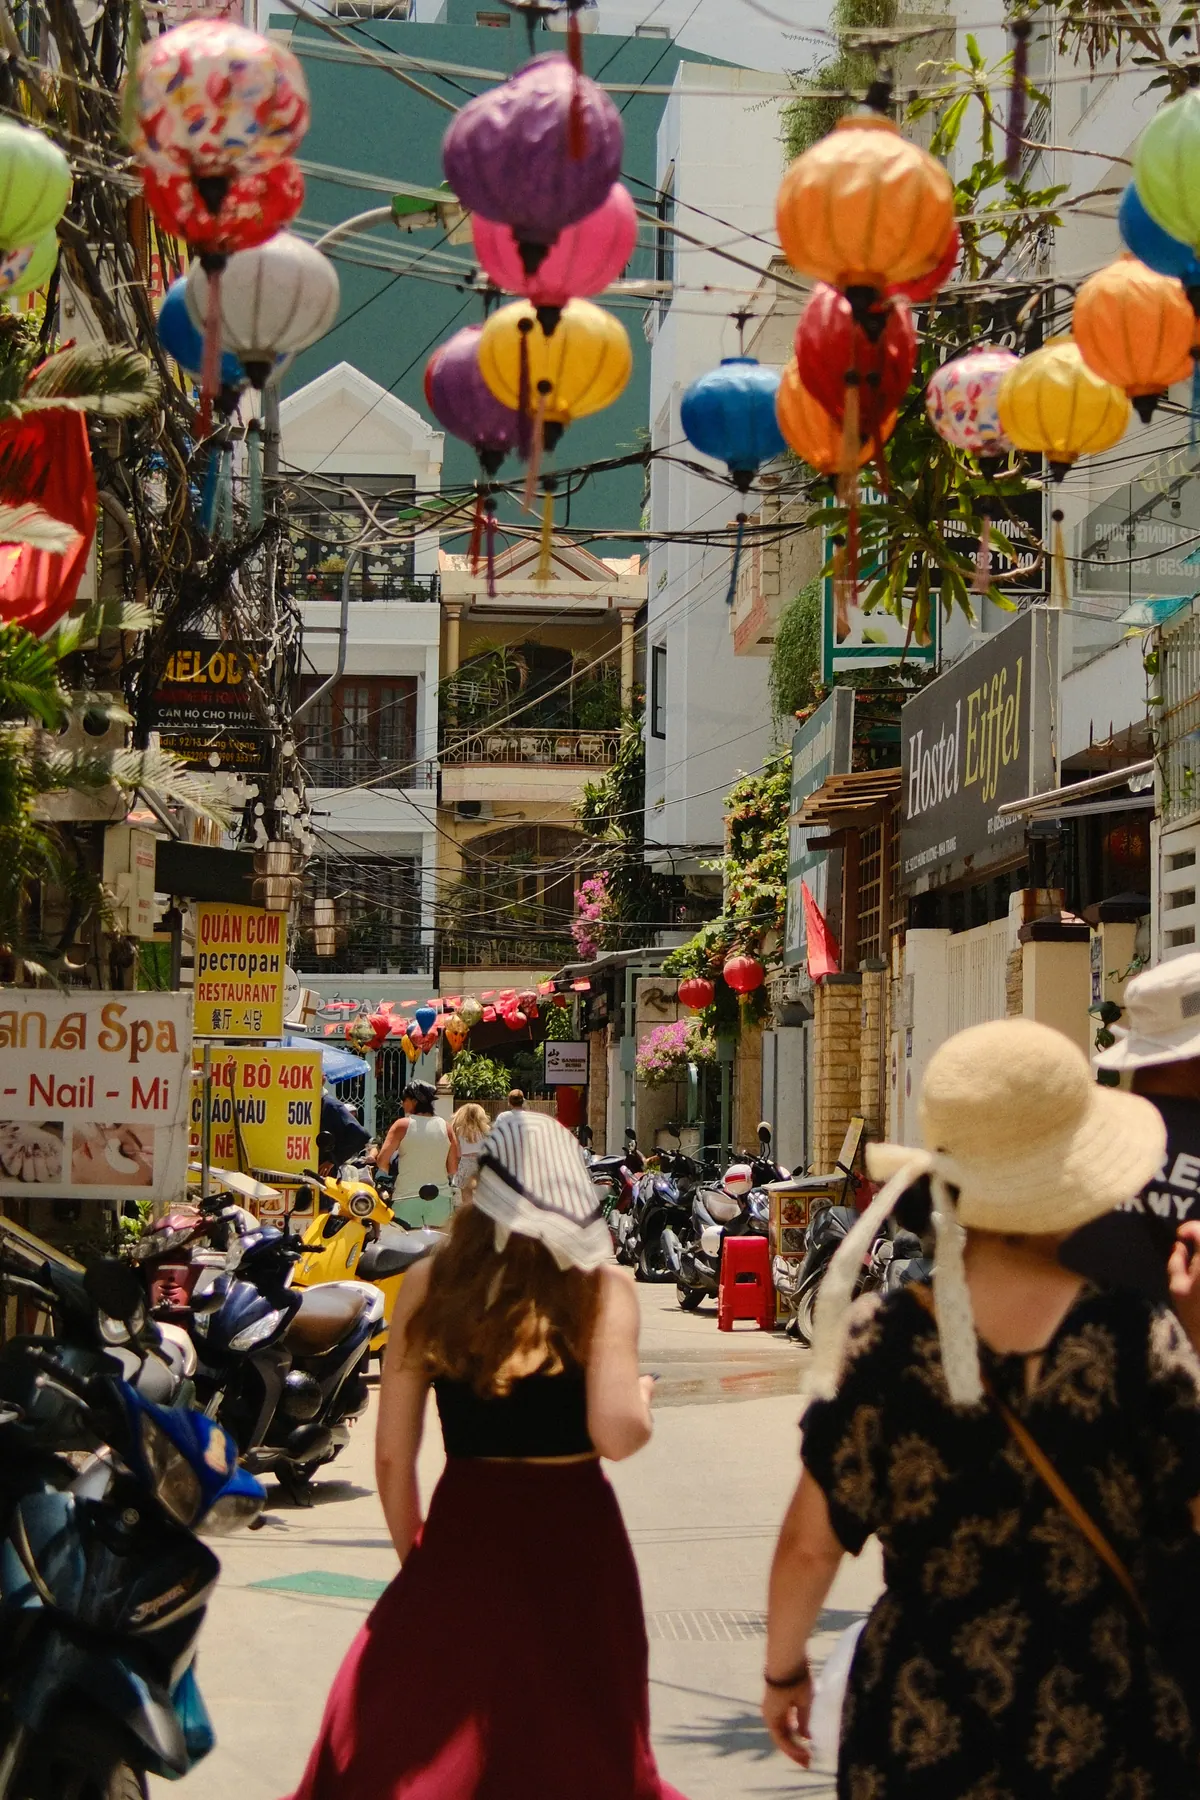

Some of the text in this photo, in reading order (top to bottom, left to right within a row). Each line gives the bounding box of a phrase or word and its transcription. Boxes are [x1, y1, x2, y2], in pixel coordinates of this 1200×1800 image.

[203, 710, 226, 720] CHO
[907, 699, 961, 820] Hostel
[964, 656, 1022, 803] Eiffel
[201, 909, 280, 945] QUÁN CƠM
[198, 952, 279, 978] ресторан
[198, 983, 277, 1003] RESTAURANT
[98, 1002, 180, 1063] Spa
[243, 1009, 263, 1031] 식당
[243, 1058, 271, 1088] BÒ
[278, 1065, 315, 1090] 40K
[28, 1073, 95, 1108] Nail
[131, 1076, 169, 1110] Mi
[192, 1094, 313, 1125] CÁO HÀU 50K
[215, 1130, 235, 1158] NÉ
[286, 1136, 311, 1160] 55K
[1114, 1191, 1196, 1220] RMY
